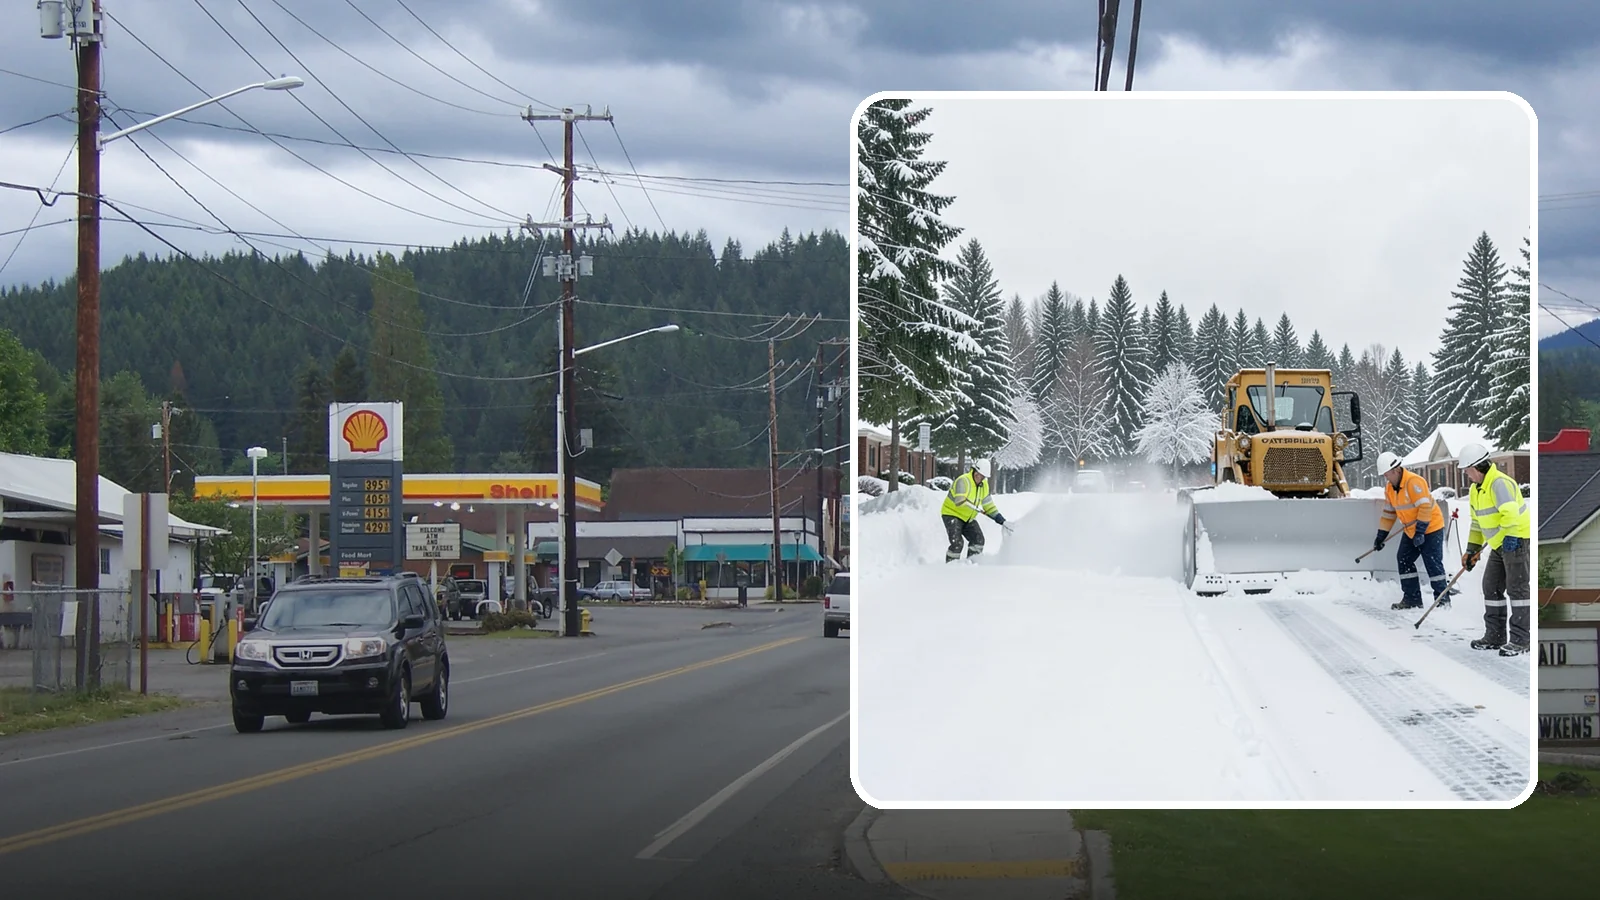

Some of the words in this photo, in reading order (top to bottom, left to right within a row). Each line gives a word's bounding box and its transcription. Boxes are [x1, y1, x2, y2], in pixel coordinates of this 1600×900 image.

[365, 480, 383, 490] 395
[490, 484, 547, 499] Shell
[365, 494, 383, 504] 405
[365, 508, 383, 518] 415
[365, 522, 383, 533] 429
